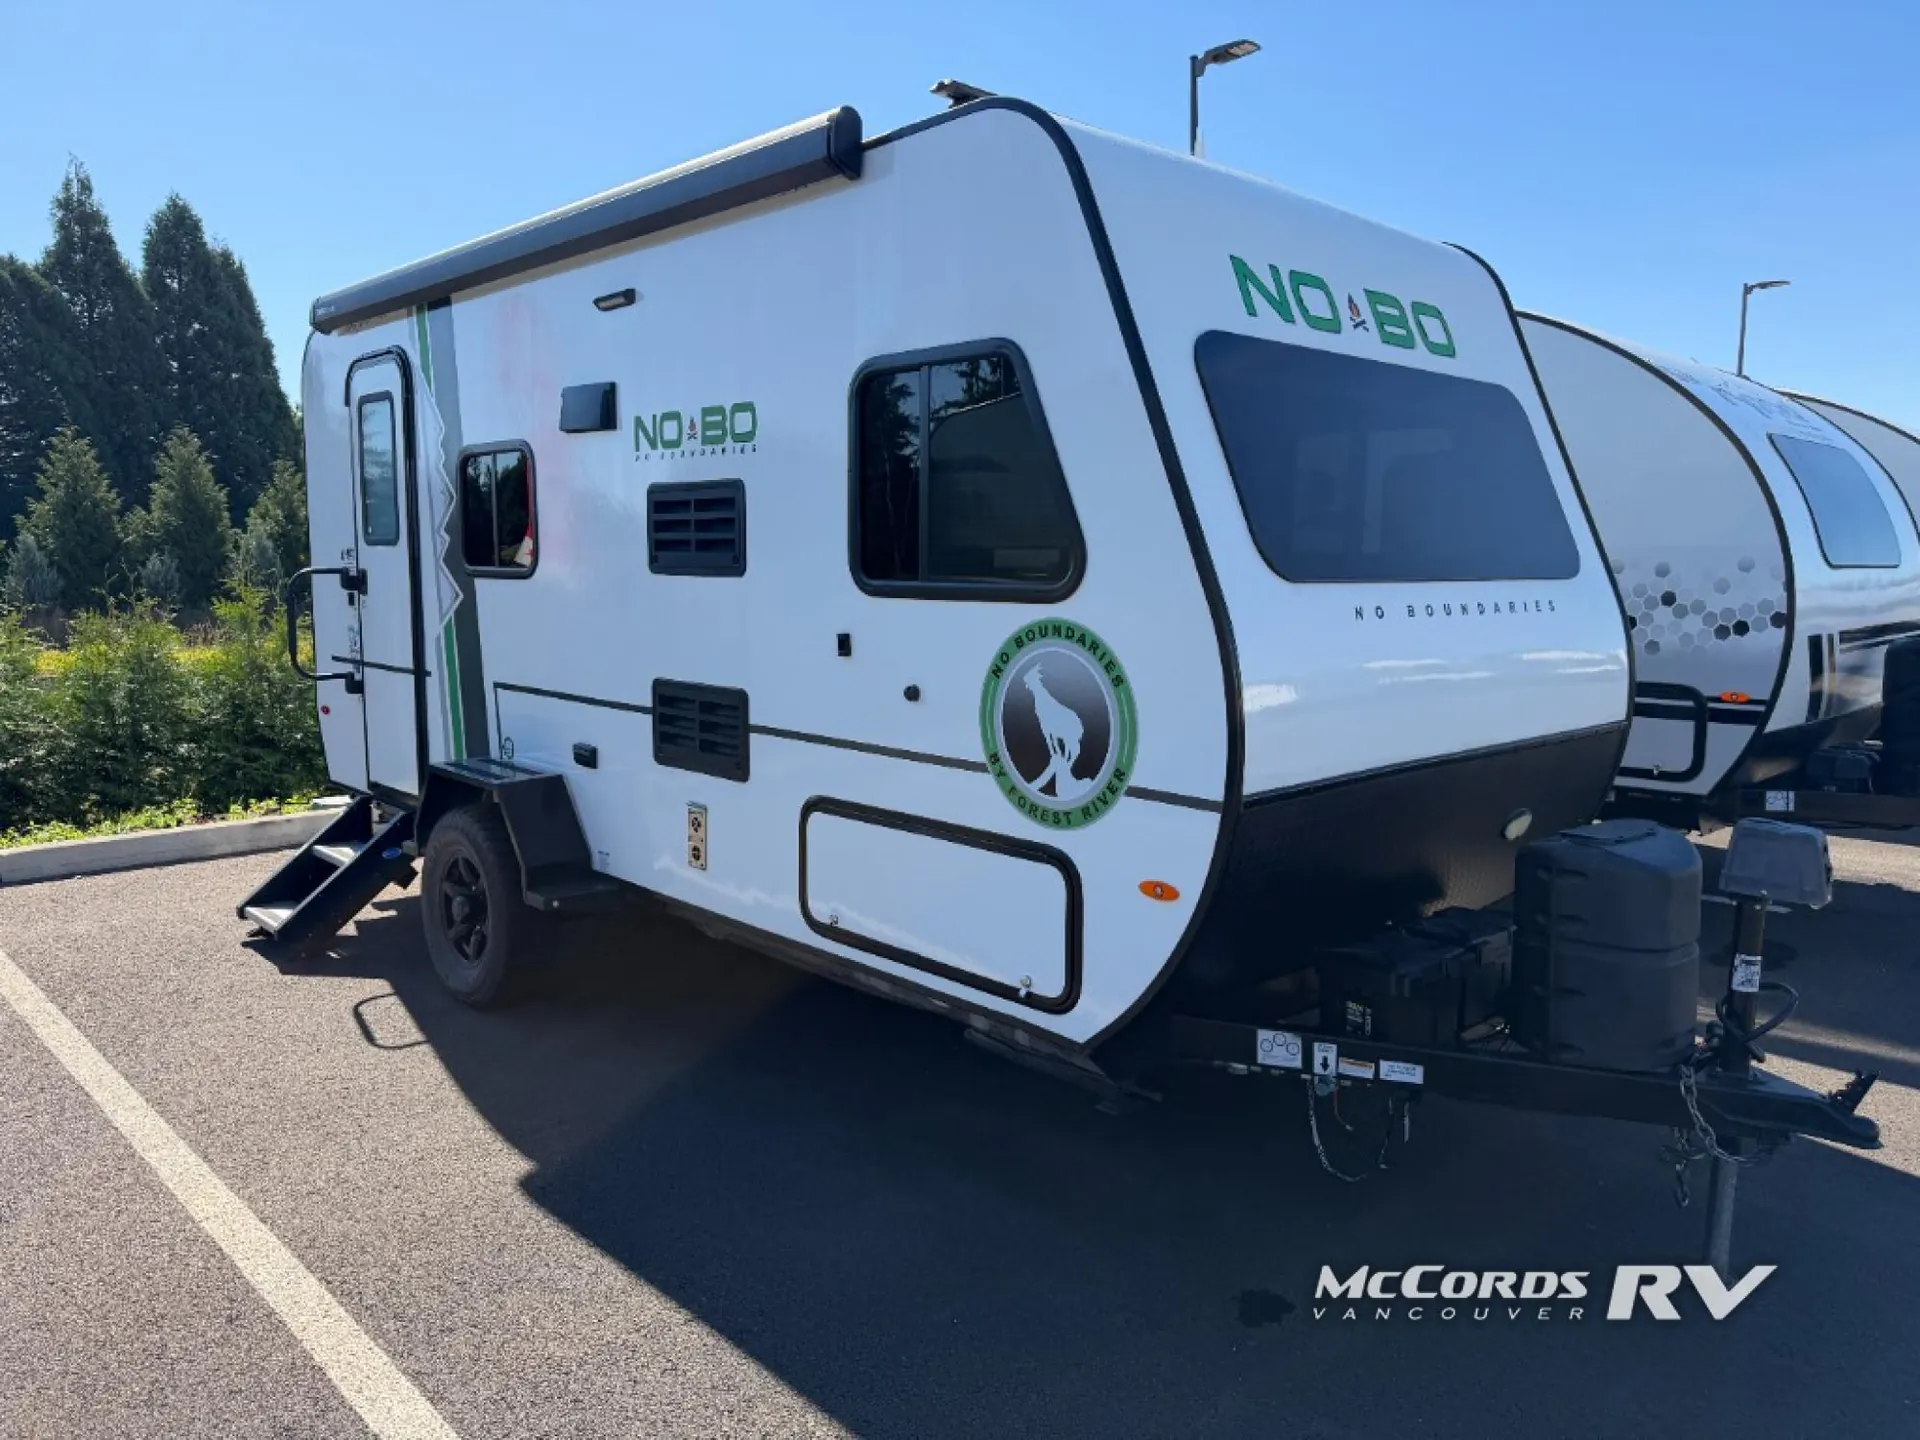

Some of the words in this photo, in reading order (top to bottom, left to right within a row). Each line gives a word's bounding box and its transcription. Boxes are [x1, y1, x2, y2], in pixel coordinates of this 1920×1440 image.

[1229, 253, 1342, 335] NO
[1363, 287, 1456, 358] BO
[634, 410, 683, 452] NO
[701, 401, 757, 445] BO
[1354, 604, 1385, 621] NO
[1406, 599, 1556, 618] BOUNDARIES
[991, 651, 1010, 679] NO
[1013, 623, 1124, 689] BOUNDARIES
[989, 752, 1007, 778] BY
[1007, 785, 1073, 826] FOREST
[1081, 767, 1127, 820] RIVER
